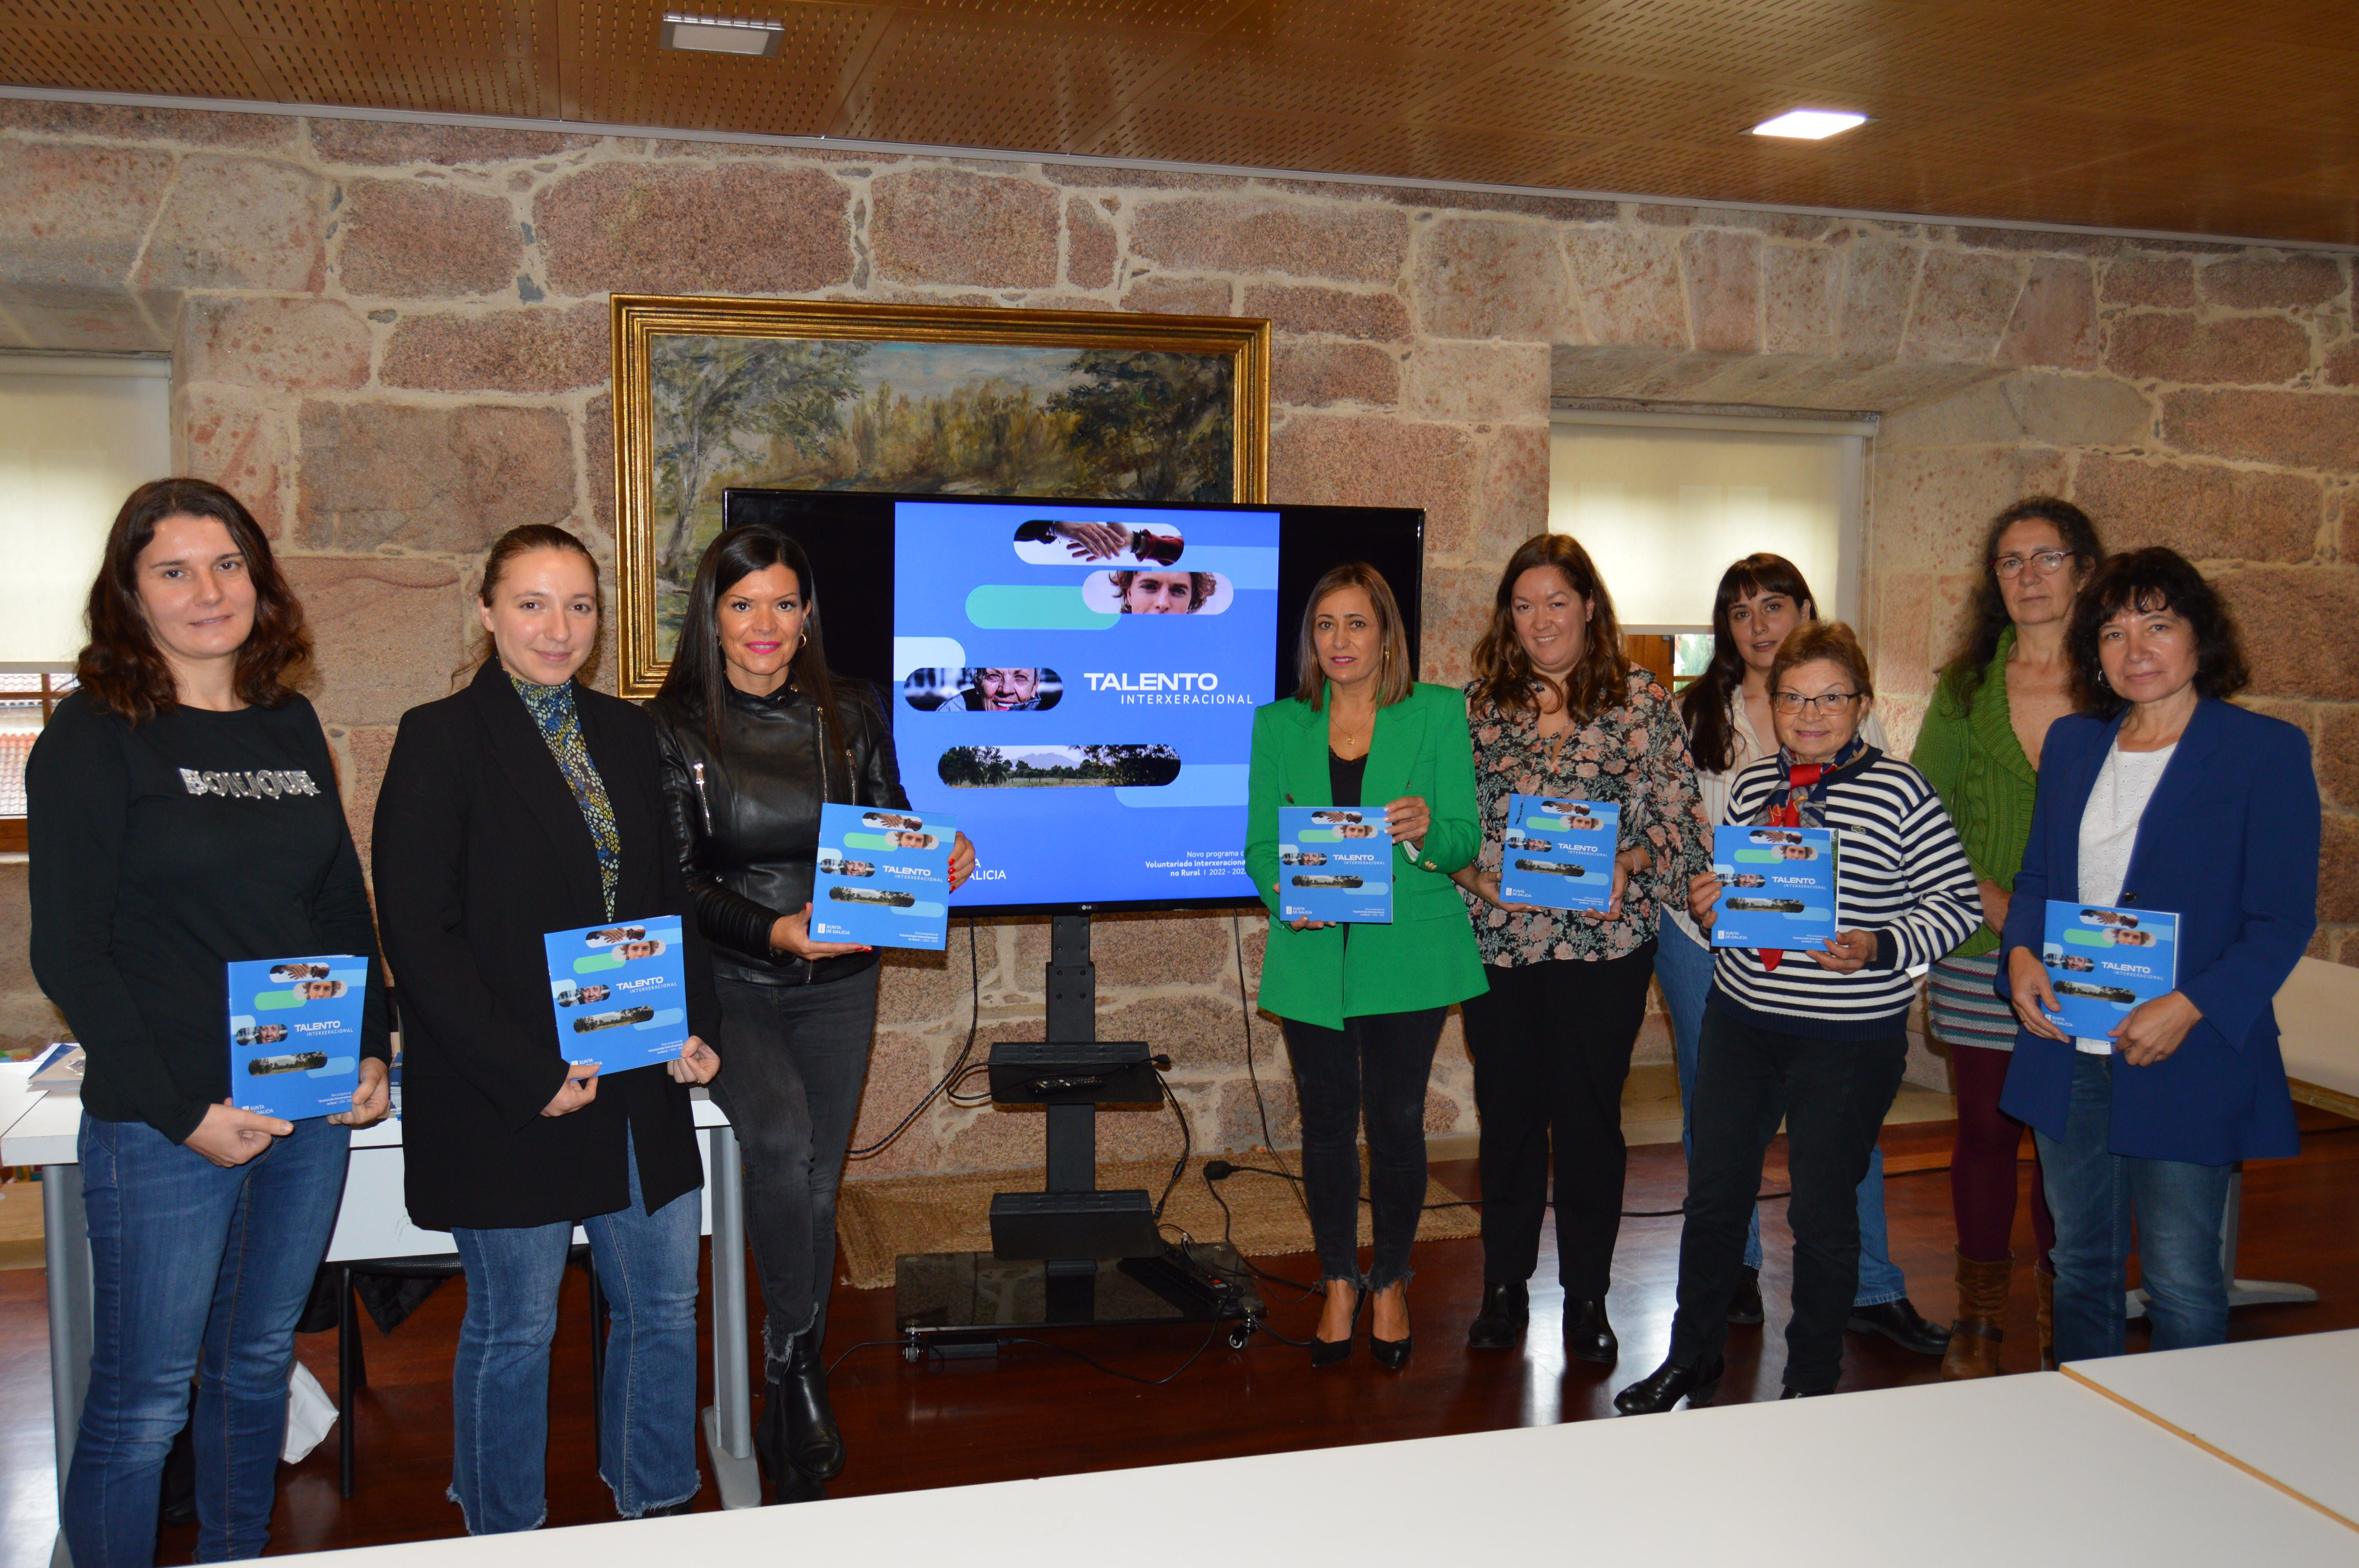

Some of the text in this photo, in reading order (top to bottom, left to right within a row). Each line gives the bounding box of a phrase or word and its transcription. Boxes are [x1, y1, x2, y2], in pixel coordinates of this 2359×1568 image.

[1084, 673, 1218, 691] TALENTO
[1121, 694, 1253, 704] INTERXERACIONAL
[179, 768, 321, 800] BONJOUR
[1558, 843, 1598, 852] TALENTO
[1145, 860, 1192, 868] Voluntariado
[883, 865, 931, 876] TALENTO
[969, 870, 1007, 880] ALICIA
[2101, 962, 2151, 974] TALENTO
[2114, 971, 2163, 980] INTERXERACIONAL
[616, 976, 663, 990] TALENTO
[630, 982, 677, 993] INTERXERACIONAL
[294, 1020, 341, 1032] TALENTO
[307, 1028, 353, 1037] INTERXERACIONAL
